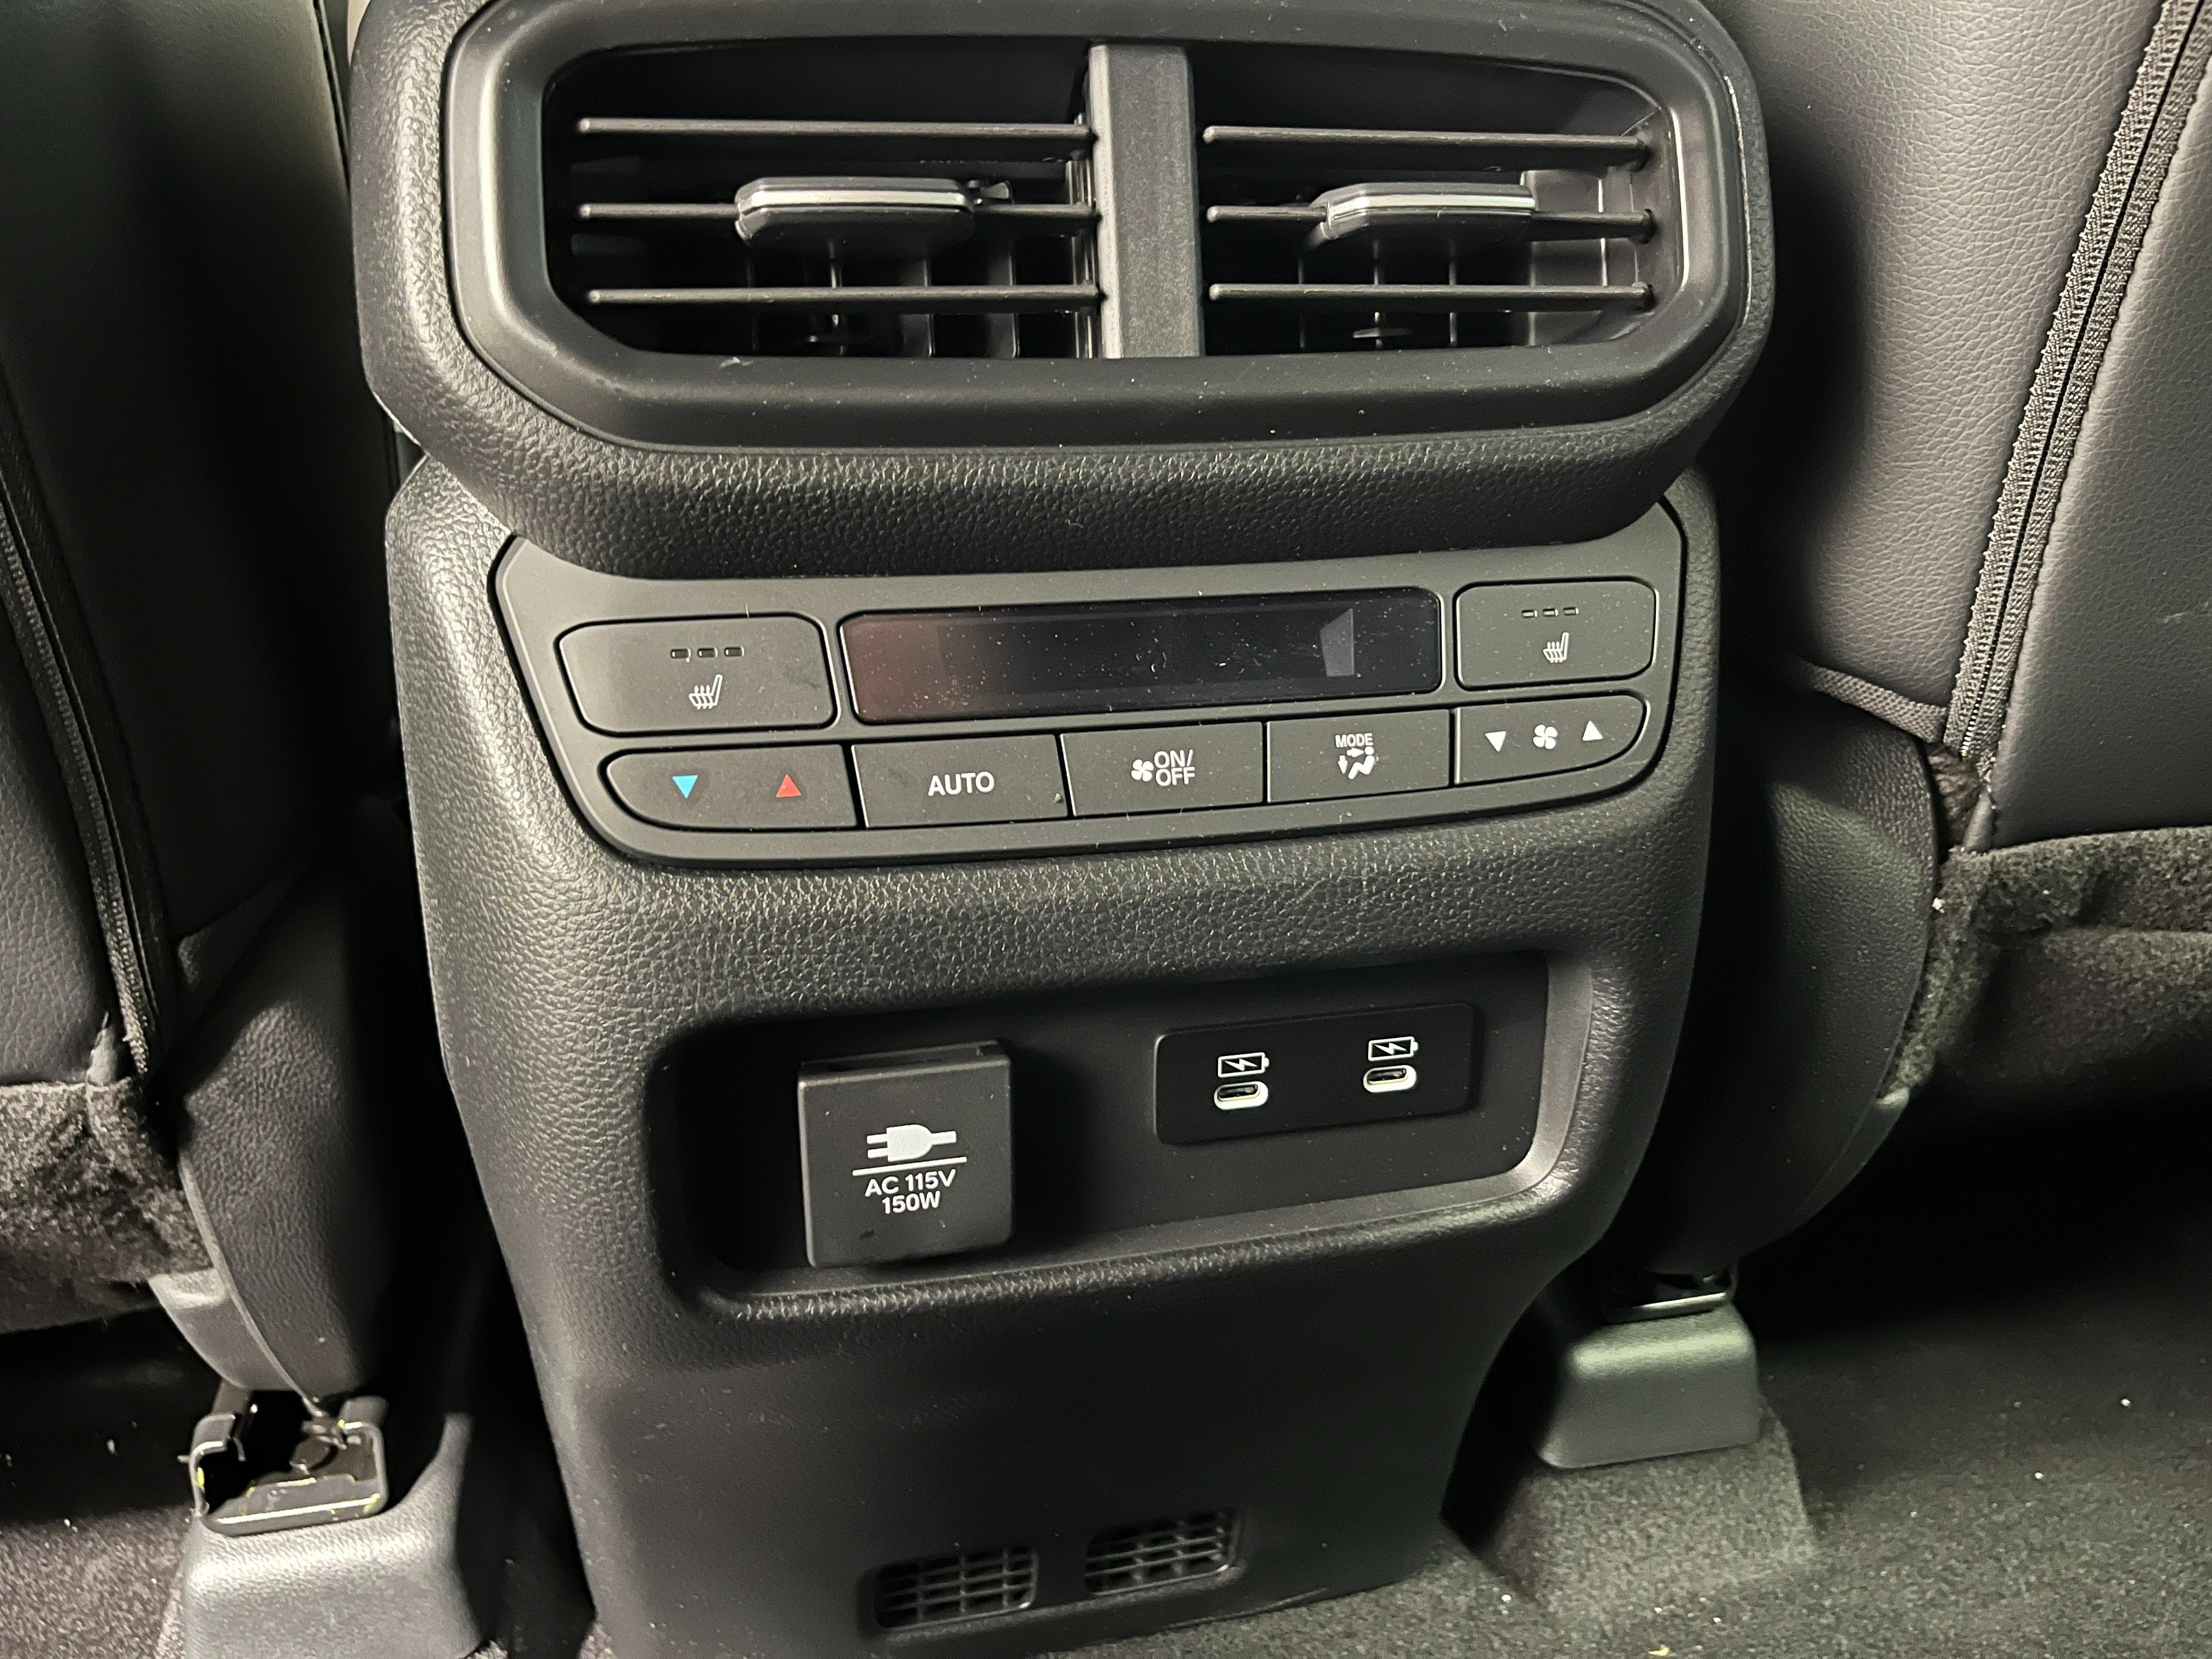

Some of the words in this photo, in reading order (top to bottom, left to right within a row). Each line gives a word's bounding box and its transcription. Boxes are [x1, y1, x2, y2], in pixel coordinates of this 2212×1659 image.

[1335, 732, 1374, 748] MODE
[1154, 749, 1194, 769] ON/
[928, 770, 995, 797] AUTO
[1155, 766, 1195, 787] OFF
[865, 1176, 899, 1197] AC
[905, 1169, 956, 1192] 115V
[882, 1190, 940, 1214] 150W
